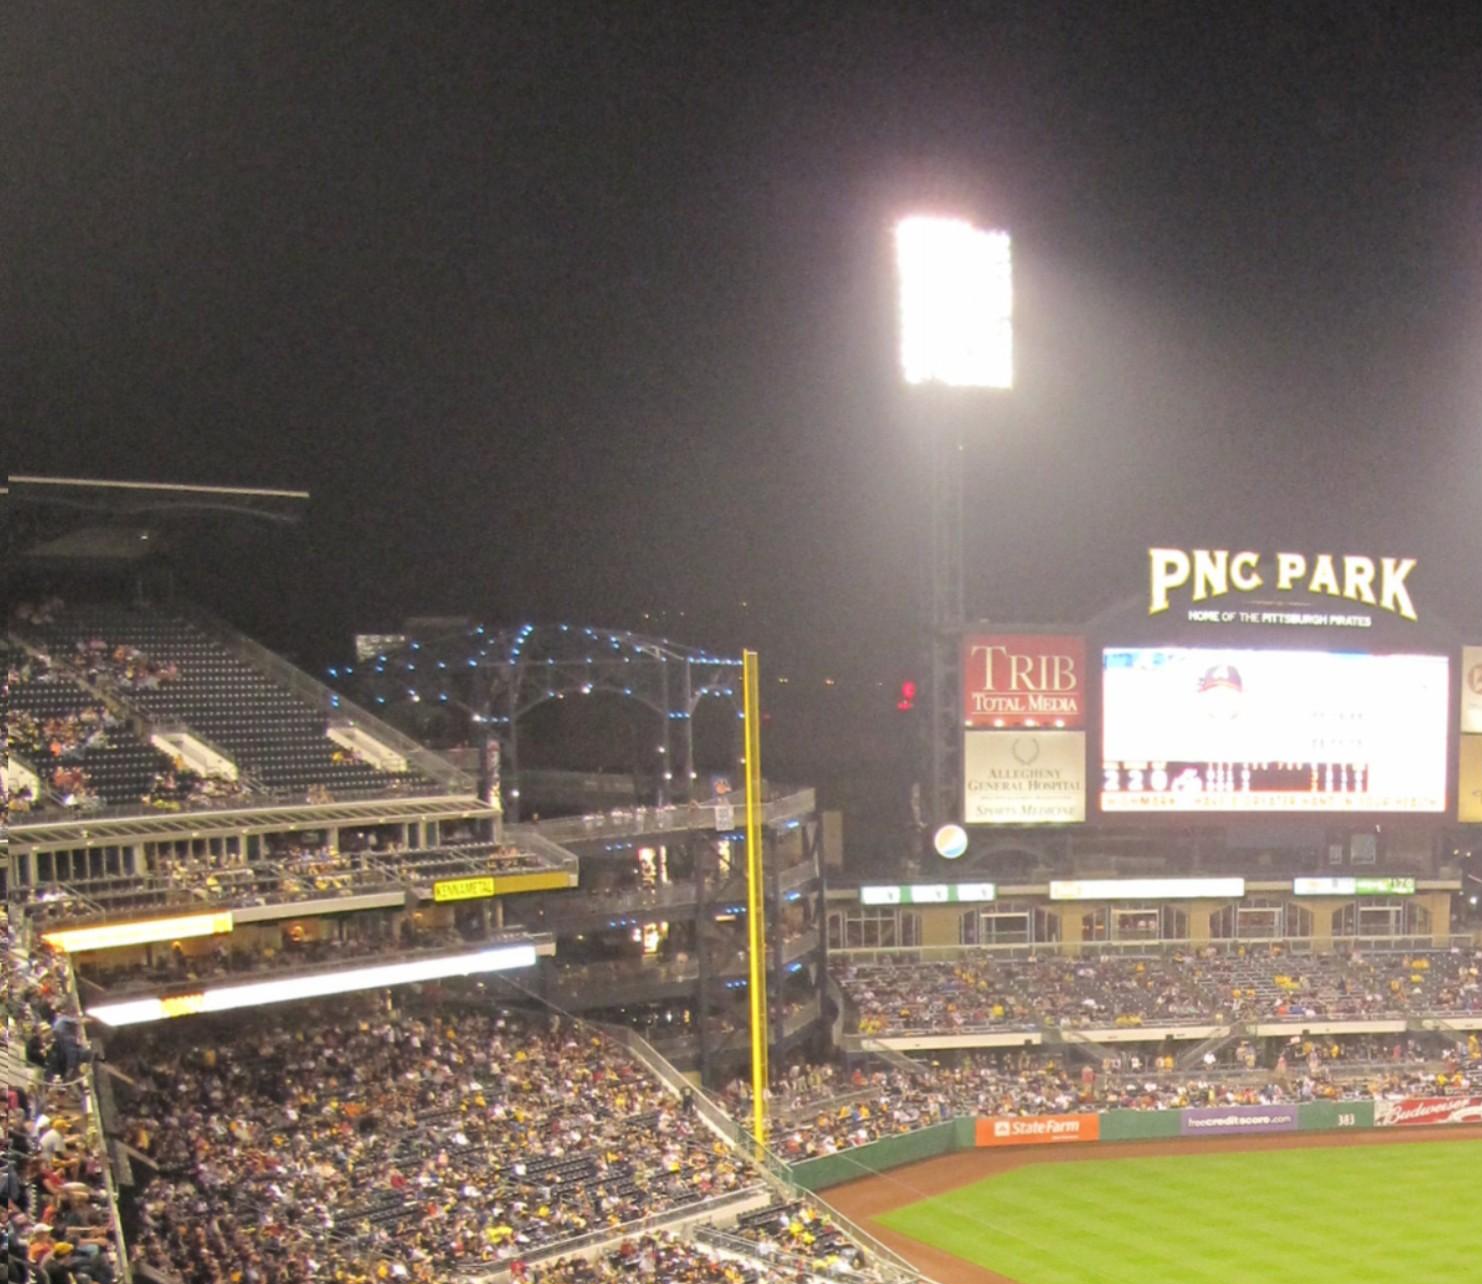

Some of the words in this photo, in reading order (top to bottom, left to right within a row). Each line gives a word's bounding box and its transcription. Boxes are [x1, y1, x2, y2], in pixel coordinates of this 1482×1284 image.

[1149, 548, 1264, 615] PNC
[1277, 553, 1418, 622] PARK
[1188, 610, 1220, 622] HOME
[1221, 611, 1237, 623] OF
[1240, 612, 1260, 624] THE
[1261, 612, 1328, 626] PITTSBURGH
[1329, 615, 1372, 627] PIRATES
[971, 645, 1078, 691] TRIB
[971, 693, 1025, 712] TOTAL
[1029, 693, 1078, 712] MEDIA
[989, 768, 1062, 780] ALLEGHENY
[968, 780, 1024, 792] GENERAL
[1027, 781, 1081, 792] HOSPITAL
[436, 880, 494, 898] KENNAMETAL
[1385, 1099, 1471, 1124] Budweiser
[1012, 1120, 1045, 1135] State
[1047, 1119, 1079, 1133] Farm
[1188, 1114, 1291, 1127] freecreditscore.com
